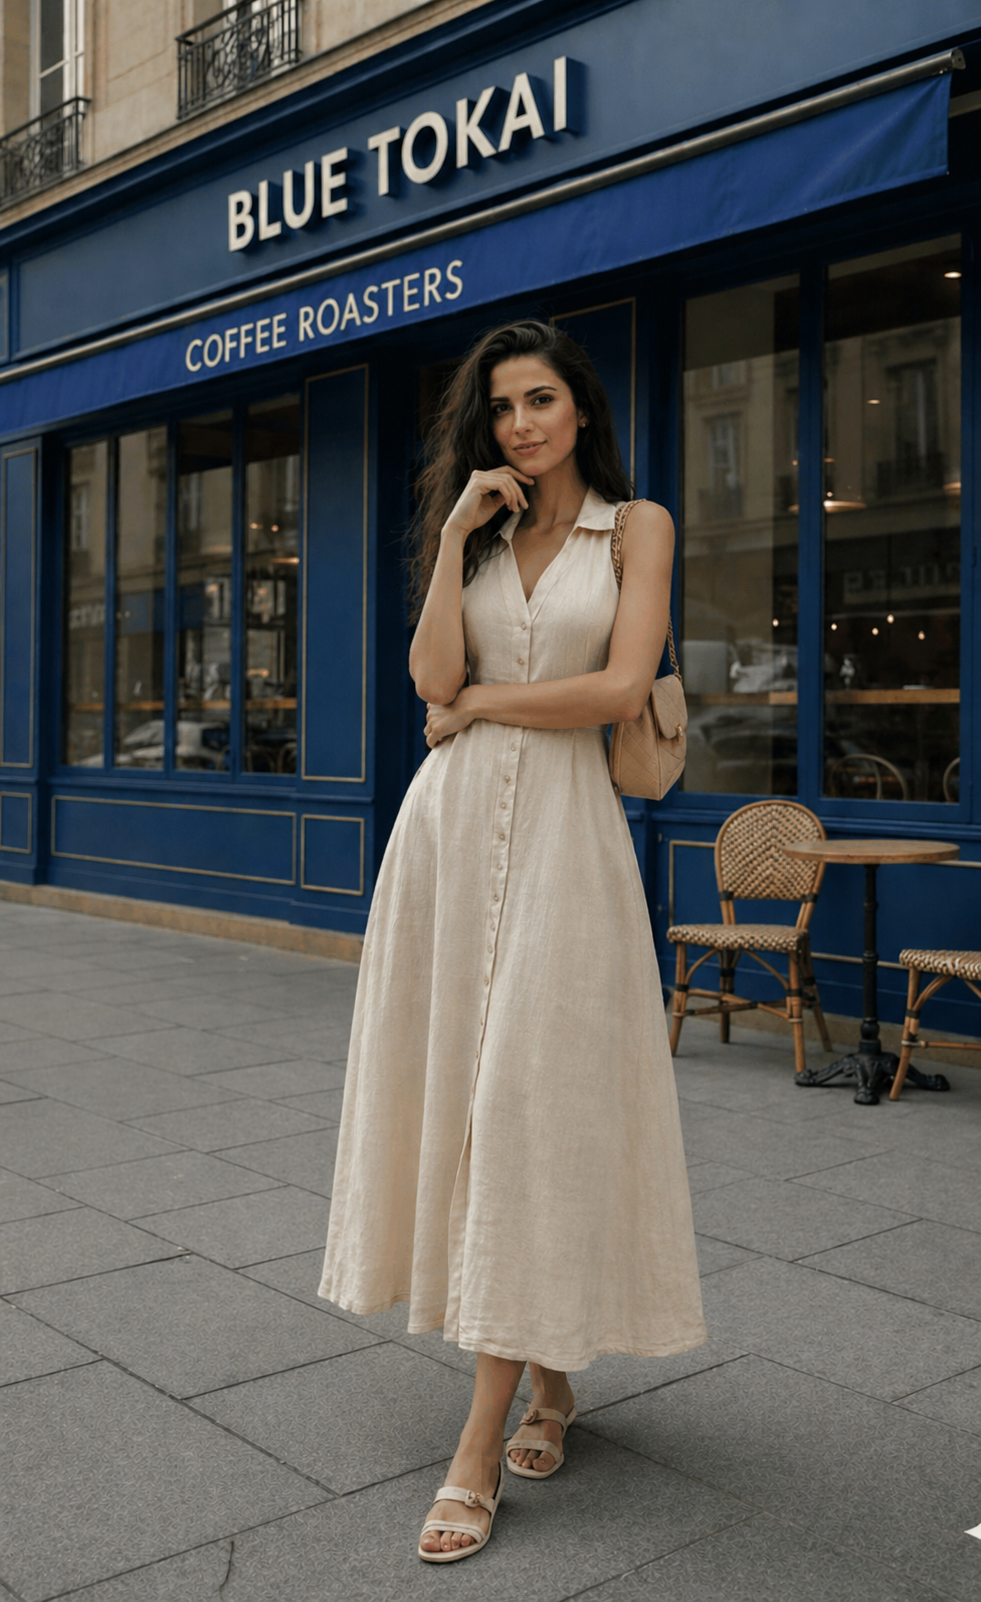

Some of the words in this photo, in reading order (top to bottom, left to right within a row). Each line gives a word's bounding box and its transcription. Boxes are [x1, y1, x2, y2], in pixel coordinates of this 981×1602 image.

[228, 146, 348, 252] BLUE
[367, 55, 568, 196] TOKAI
[185, 312, 287, 372] COFFEE
[298, 259, 464, 342] ROASTERS
